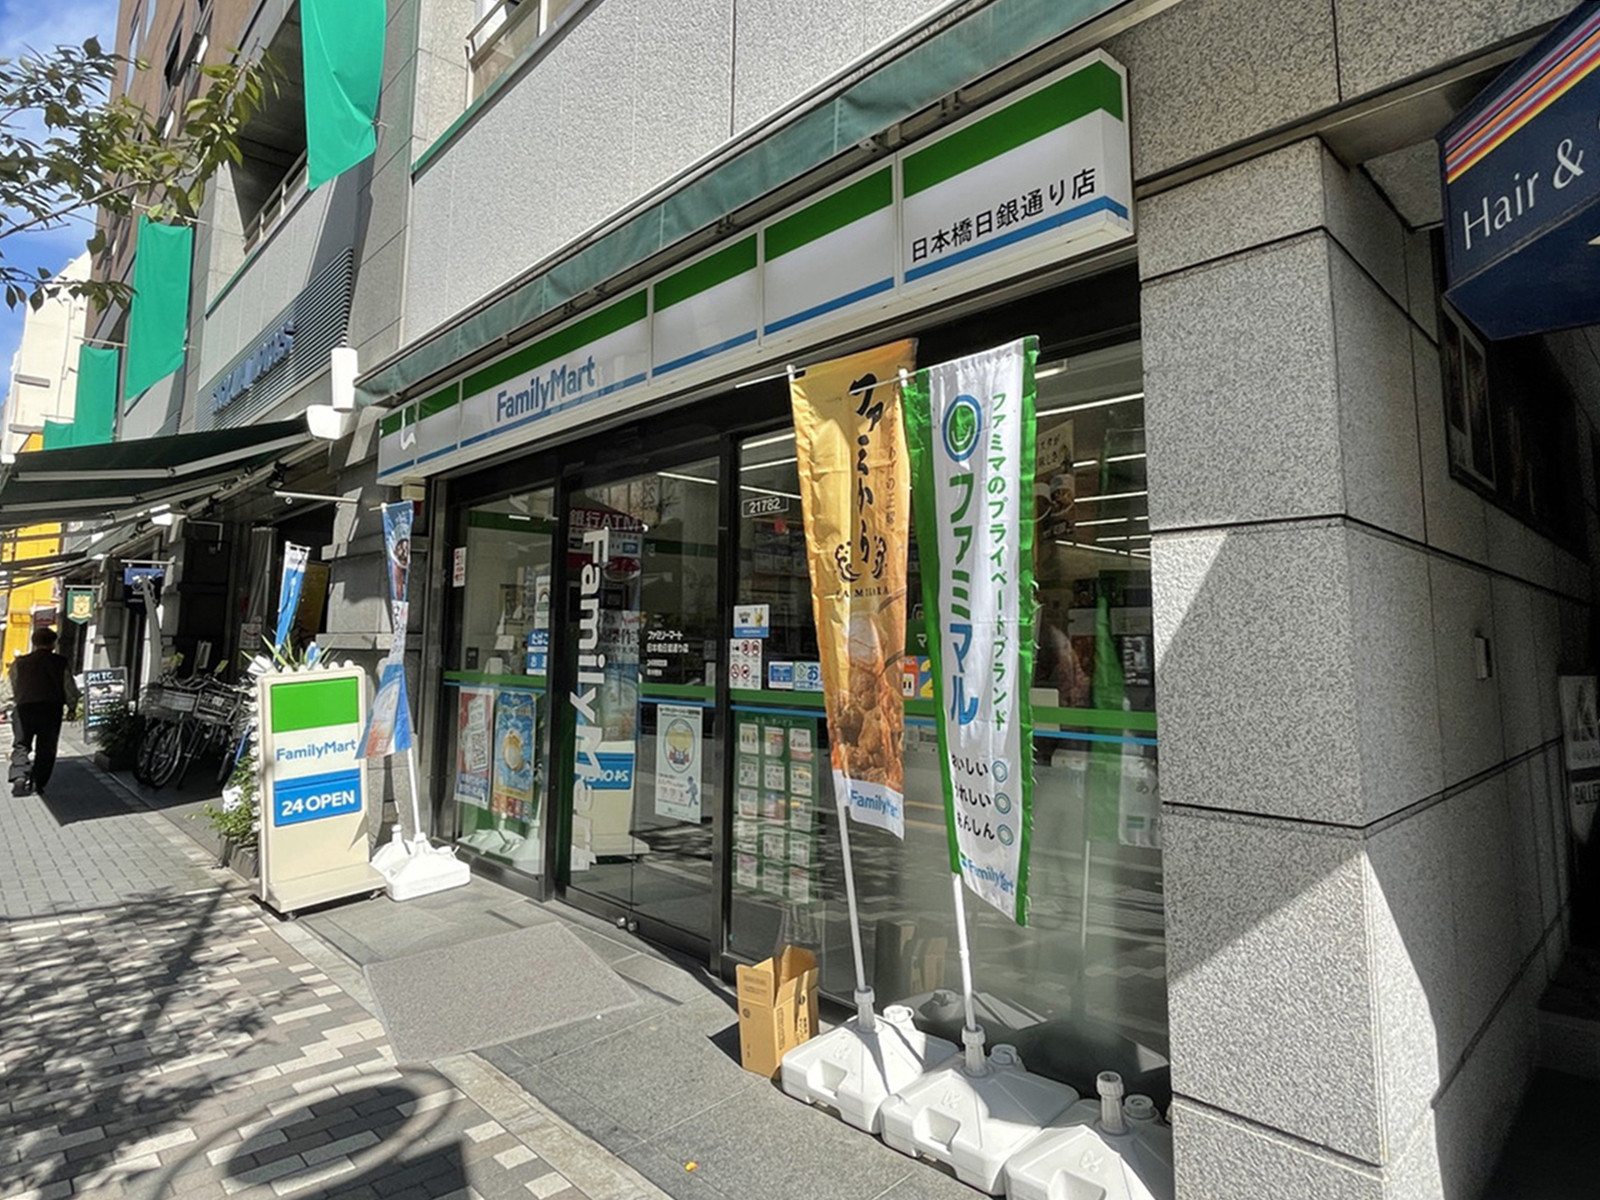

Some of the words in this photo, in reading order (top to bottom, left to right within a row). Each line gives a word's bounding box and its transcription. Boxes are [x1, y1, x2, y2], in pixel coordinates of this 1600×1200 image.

[912, 168, 1096, 262] 日本橋日銀通り店
[1462, 170, 1539, 251] Hair
[1552, 138, 1585, 190] &
[496, 355, 596, 422] FamilyMart
[749, 497, 781, 514] 21782
[949, 472, 978, 726] ファミマル
[987, 393, 1009, 731] ファミマのプライベートブランド
[276, 738, 357, 762] FamilyMart
[568, 527, 611, 872] FamilyMart
